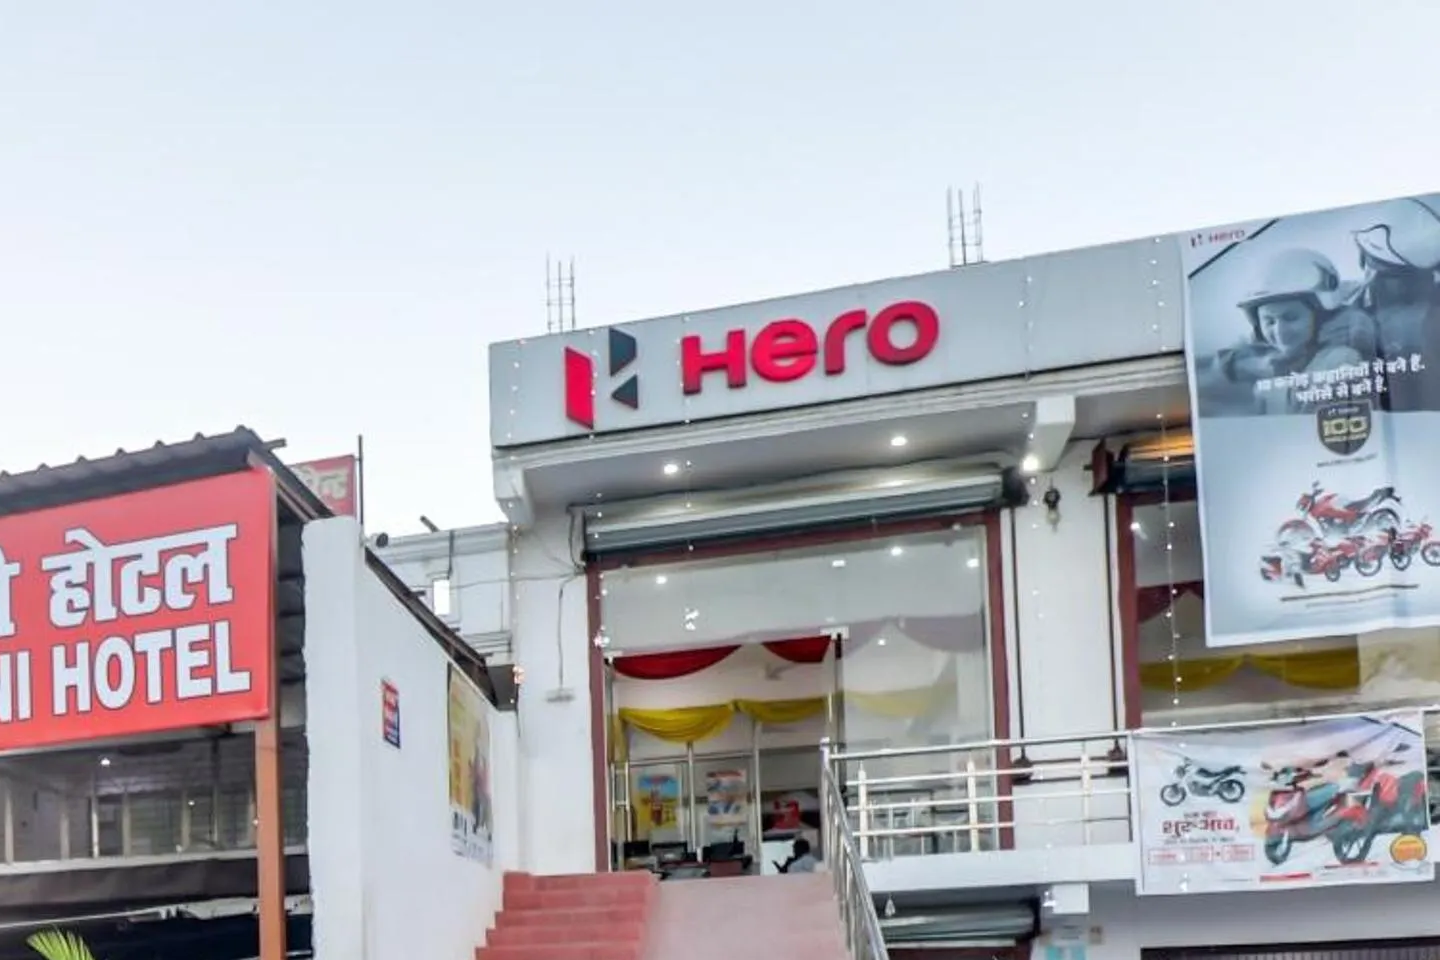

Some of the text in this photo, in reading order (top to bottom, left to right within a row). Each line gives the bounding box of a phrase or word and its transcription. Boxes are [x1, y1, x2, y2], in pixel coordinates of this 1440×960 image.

[681, 300, 940, 395] Hero
[1322, 416, 1368, 437] 100
[42, 524, 237, 628] होटल
[53, 621, 251, 715] HOTEL
